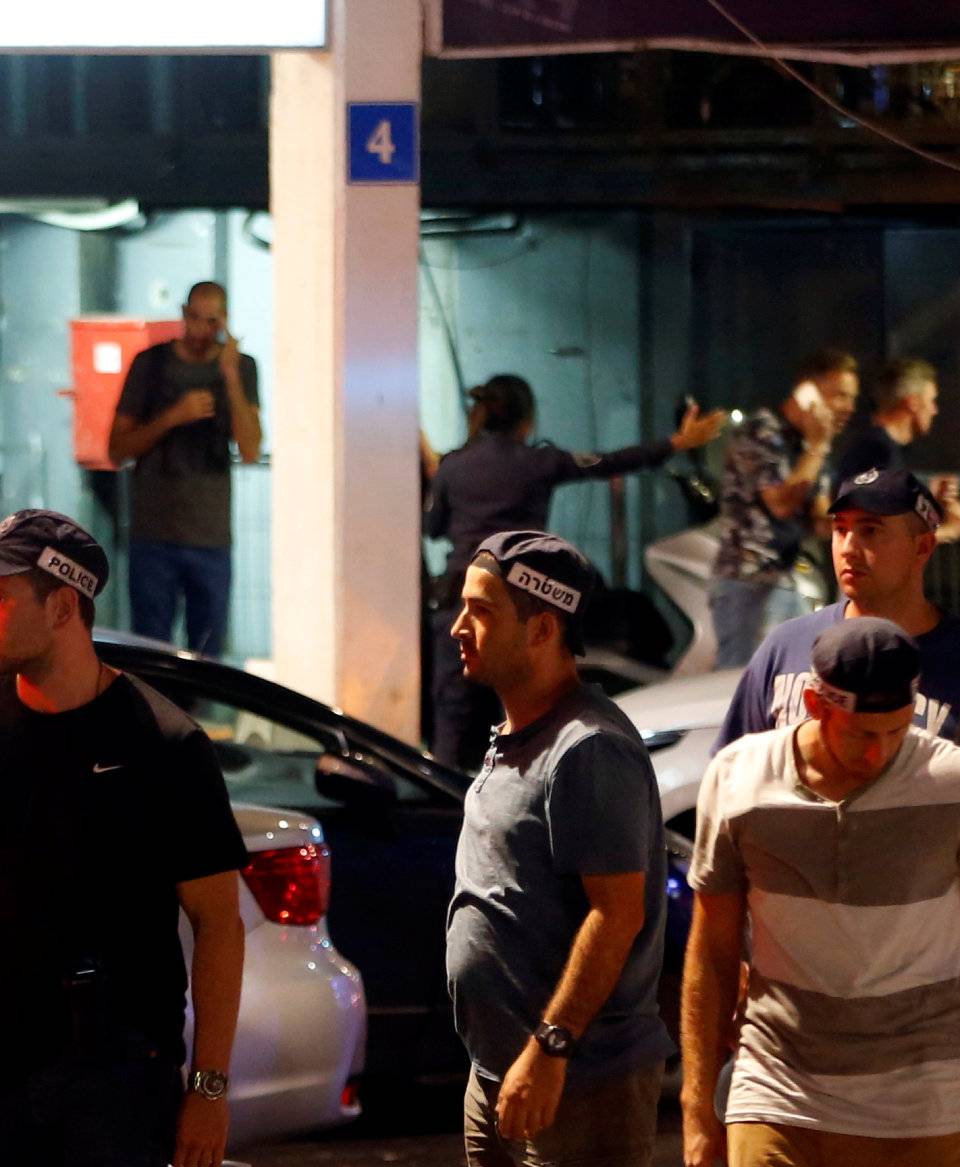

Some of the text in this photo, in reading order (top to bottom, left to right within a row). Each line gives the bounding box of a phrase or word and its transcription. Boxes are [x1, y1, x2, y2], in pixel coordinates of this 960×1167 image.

[366, 120, 397, 164] 4
[48, 557, 94, 592] POLICE
[518, 571, 575, 607] משטרה
